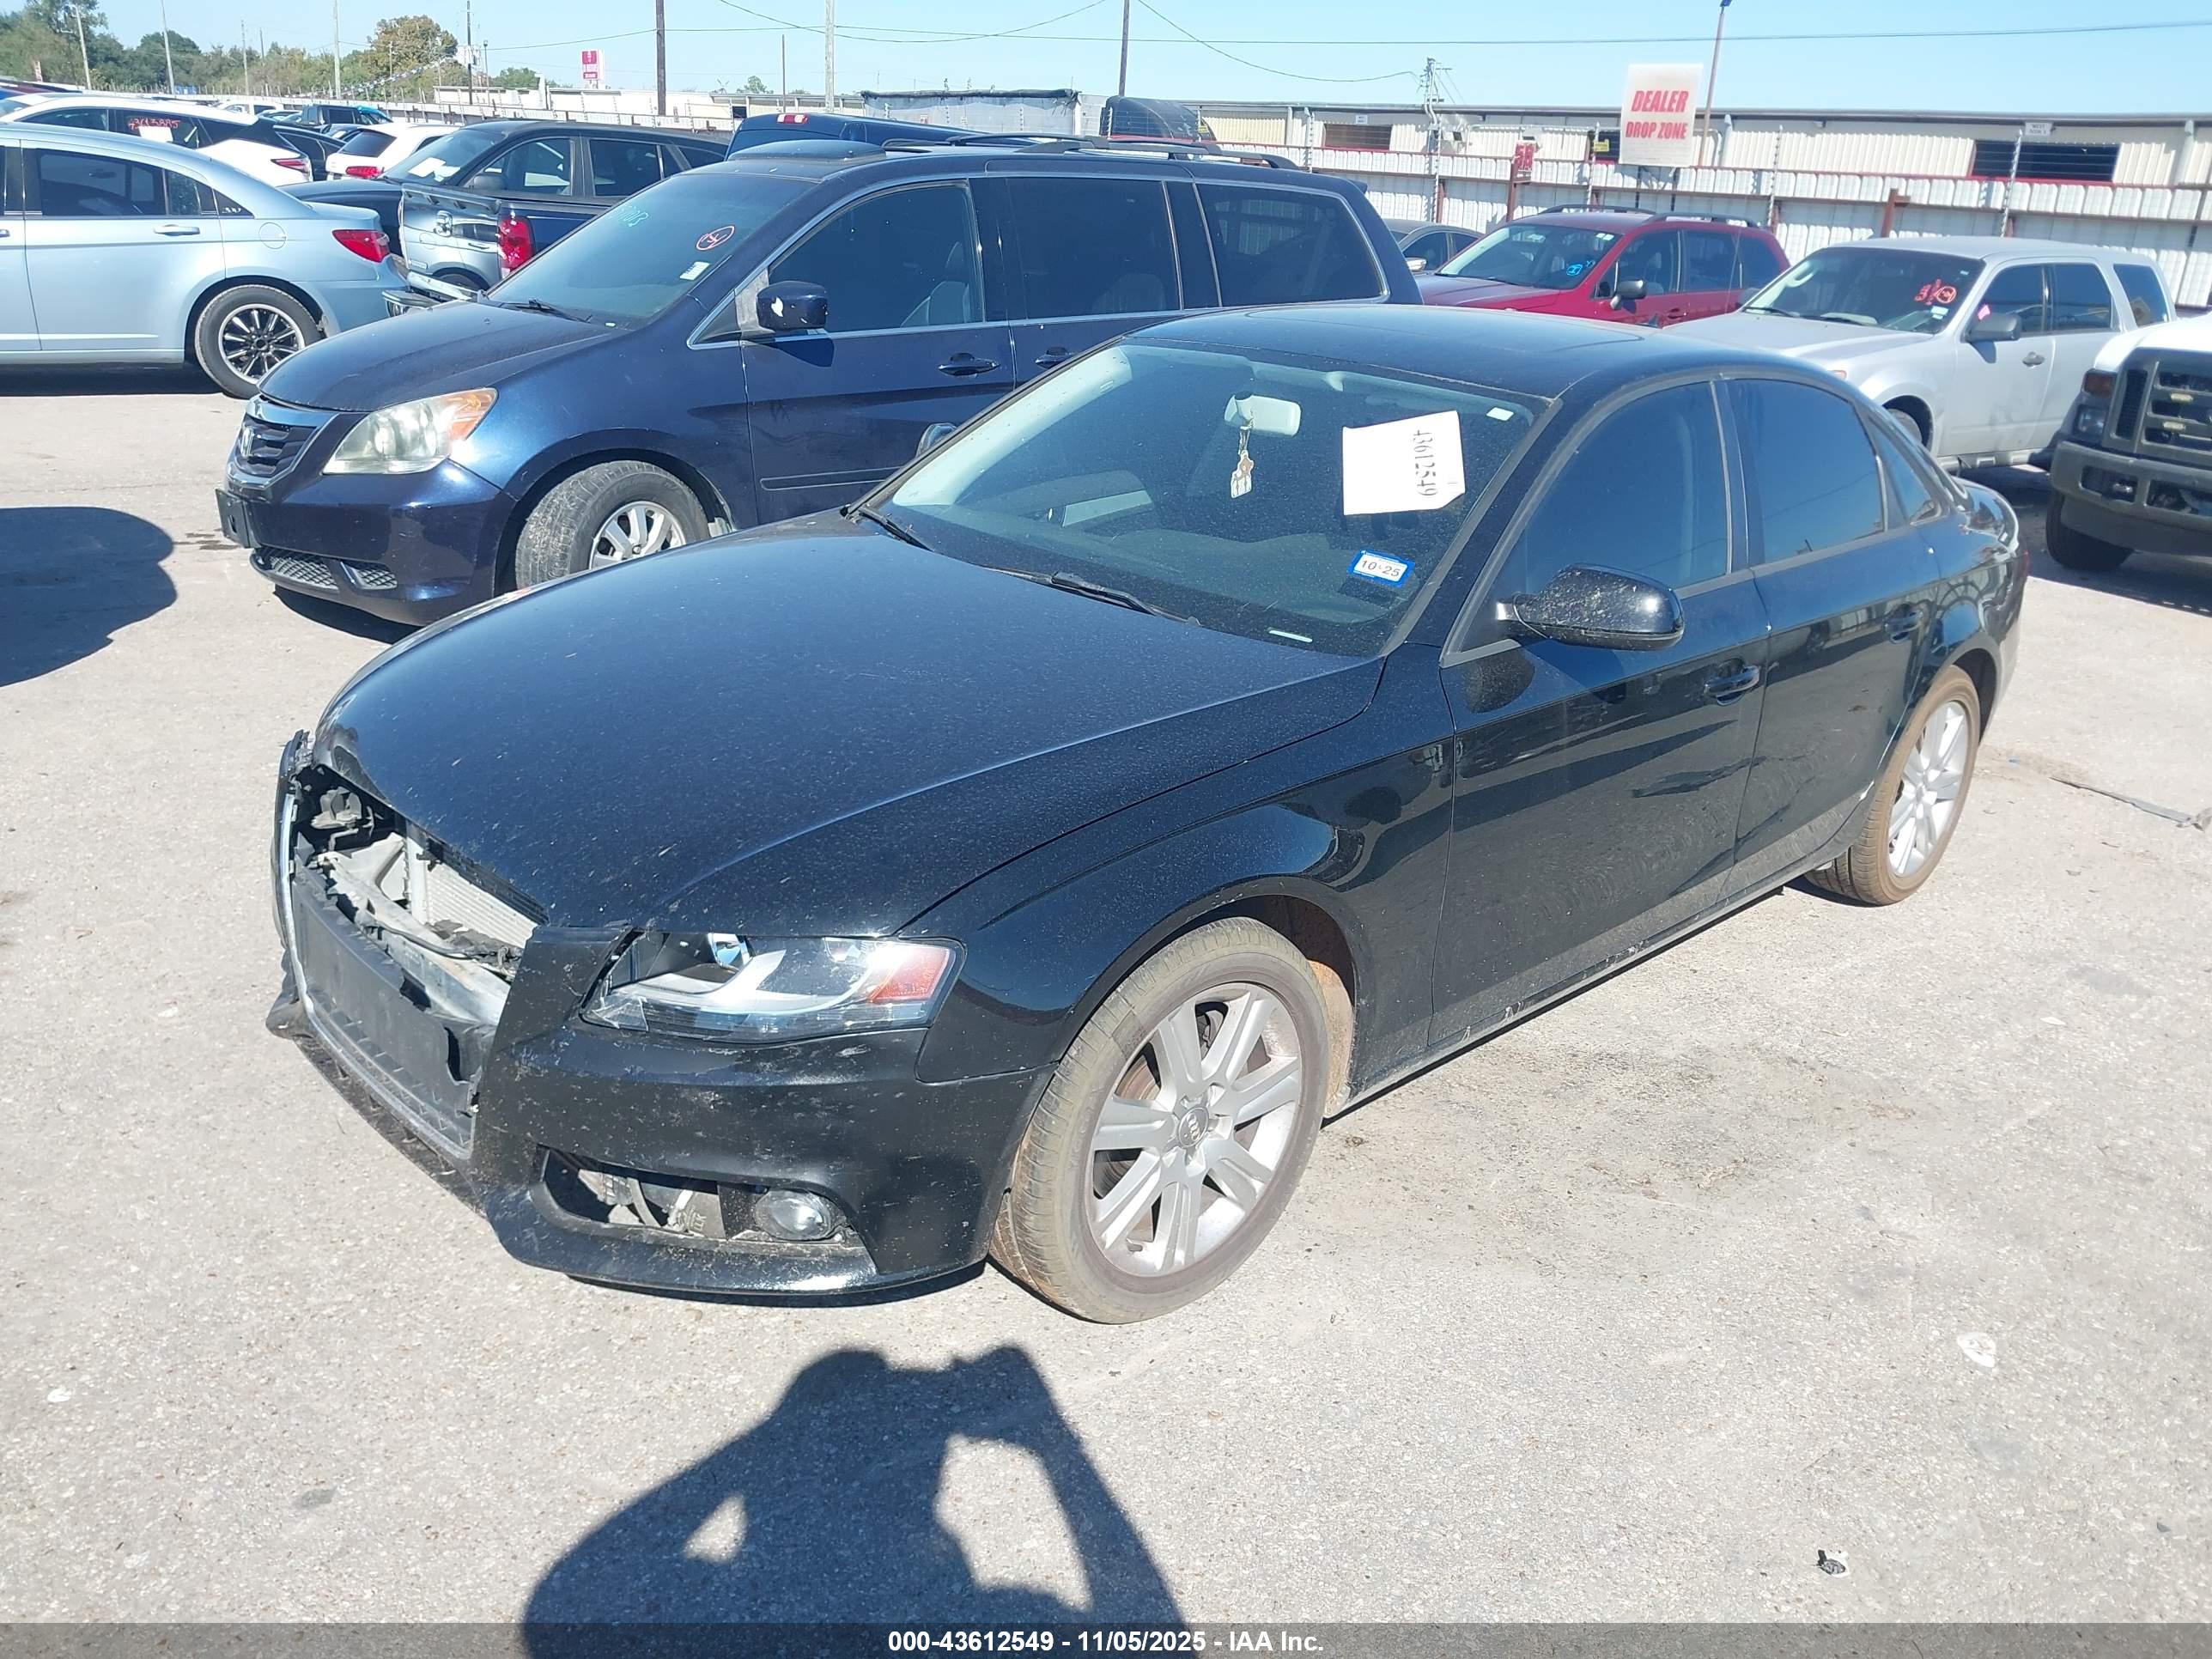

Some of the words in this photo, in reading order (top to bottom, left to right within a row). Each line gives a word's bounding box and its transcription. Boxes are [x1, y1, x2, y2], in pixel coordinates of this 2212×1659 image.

[1632, 90, 1689, 112] DEALER
[1626, 121, 1657, 138] DROP
[1657, 122, 1687, 140] ZONE
[1413, 429, 1438, 496] 43612549
